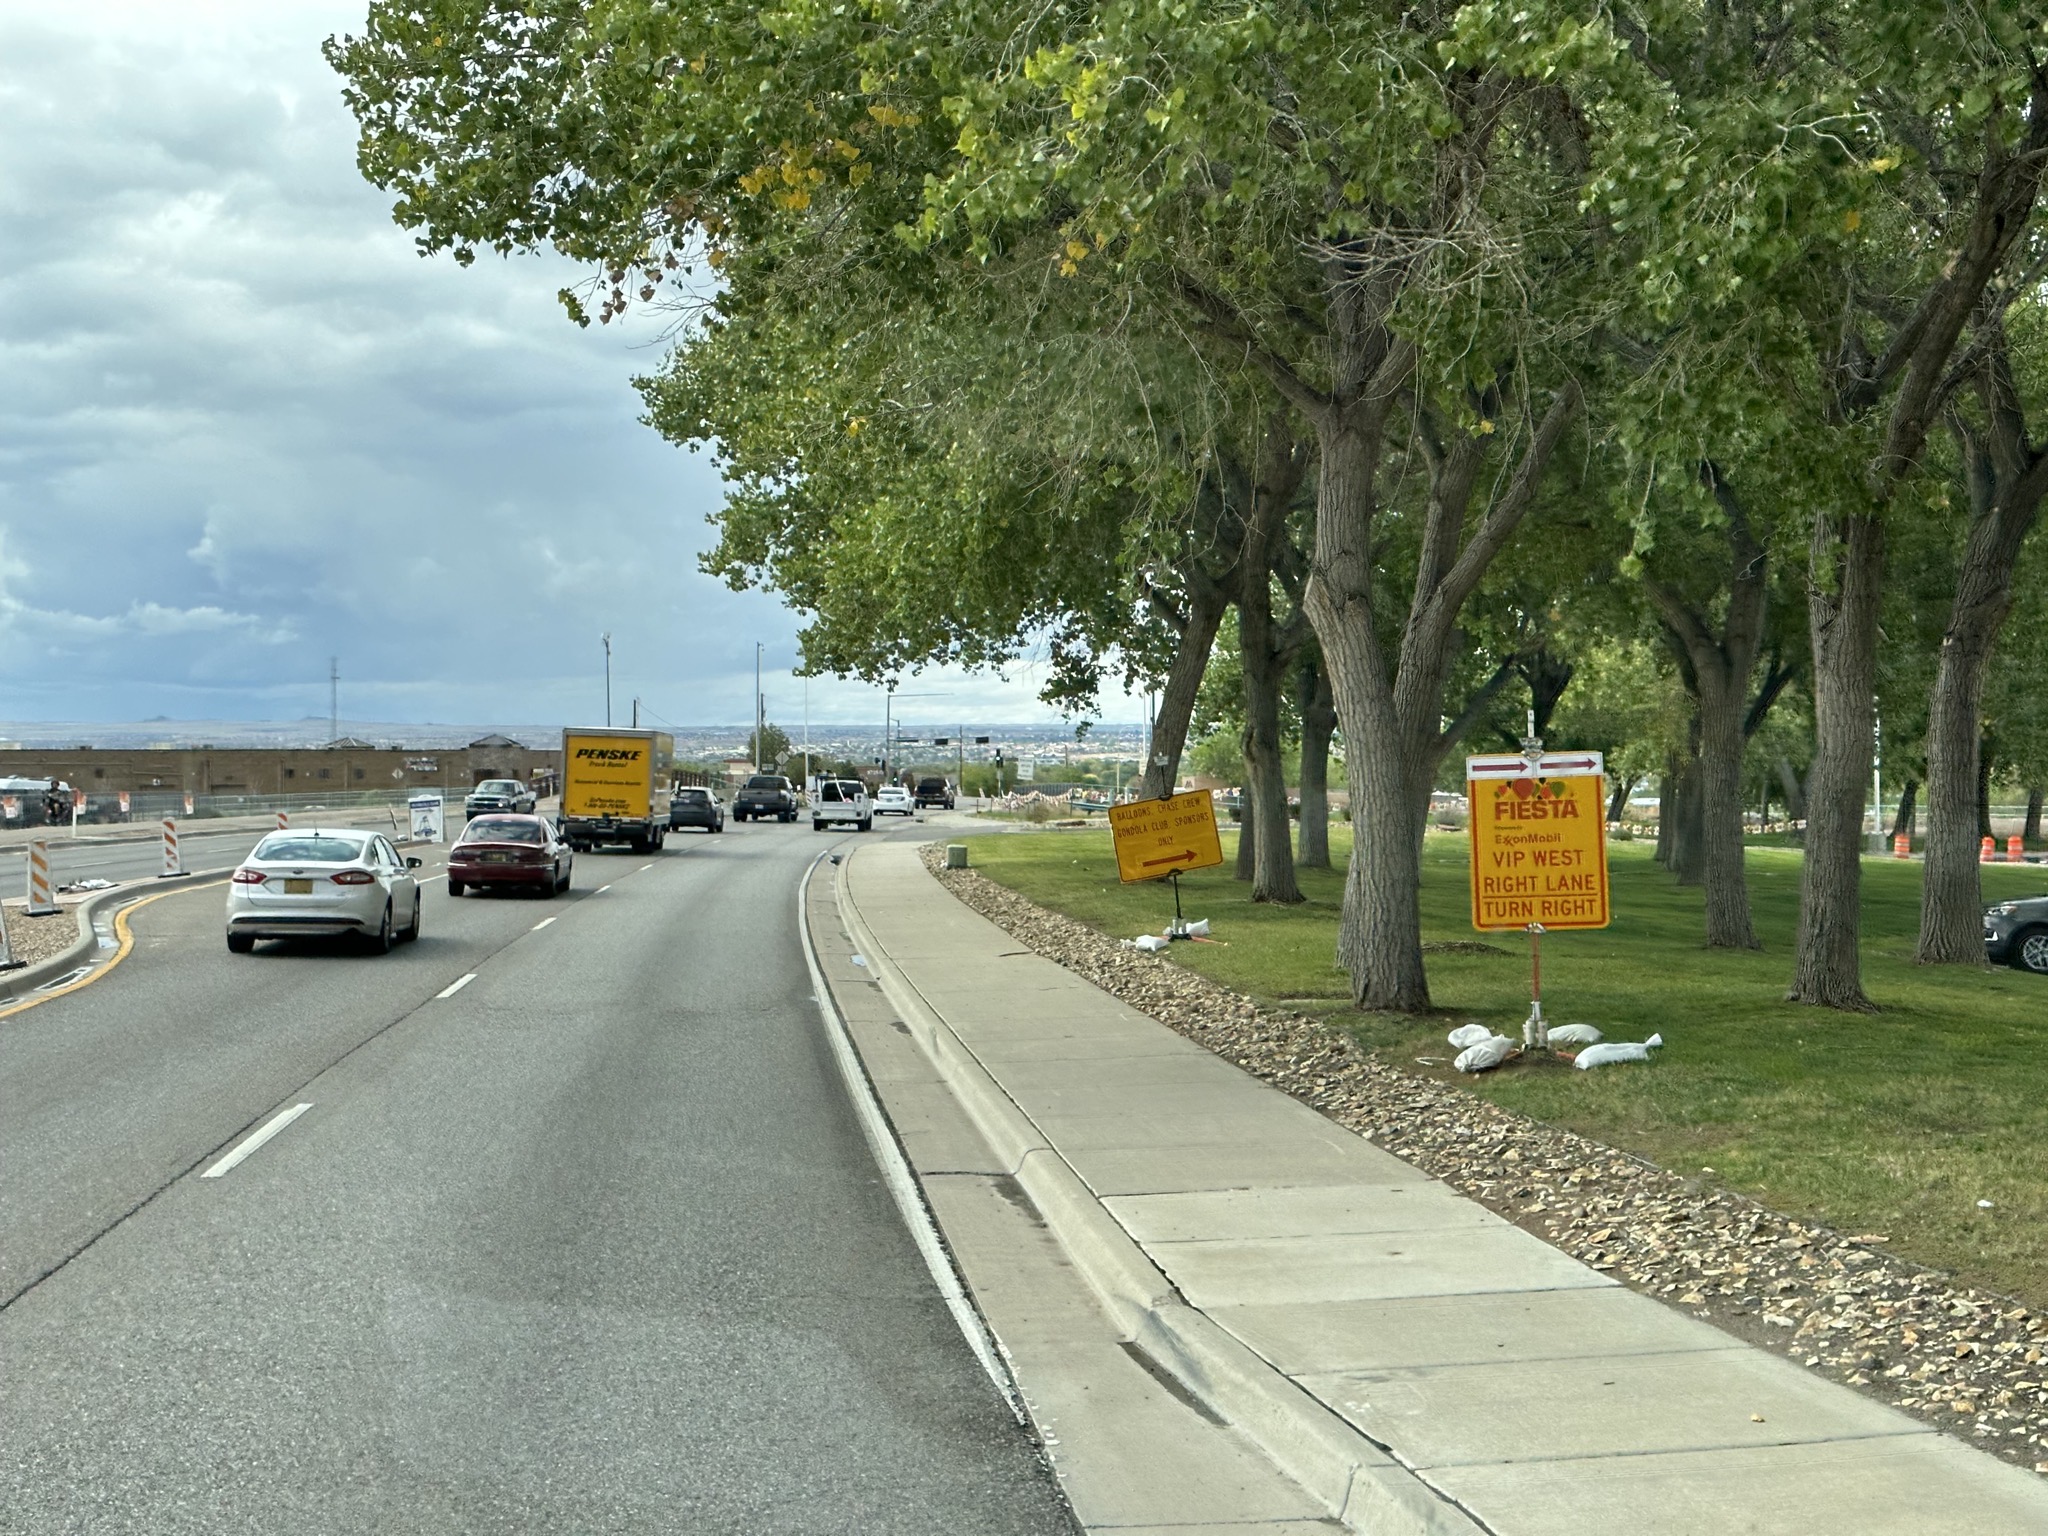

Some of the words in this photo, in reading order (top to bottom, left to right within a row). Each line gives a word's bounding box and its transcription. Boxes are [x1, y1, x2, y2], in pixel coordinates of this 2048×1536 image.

[576, 748, 642, 760] PENSKE
[1158, 801, 1179, 813] CHASE
[1494, 800, 1579, 820] FIESTA
[1118, 824, 1148, 838] GONDOLA
[1175, 812, 1209, 827] SPONSORS
[1158, 836, 1174, 846] ONLY
[1495, 833, 1561, 846] ExxonMobil
[1493, 851, 1525, 867] VIP
[1532, 850, 1583, 866] WEST
[1484, 876, 1538, 893] RIGHT
[1546, 874, 1596, 891] LANE
[1484, 901, 1533, 918] TURN
[1542, 899, 1597, 916] RIGHT
